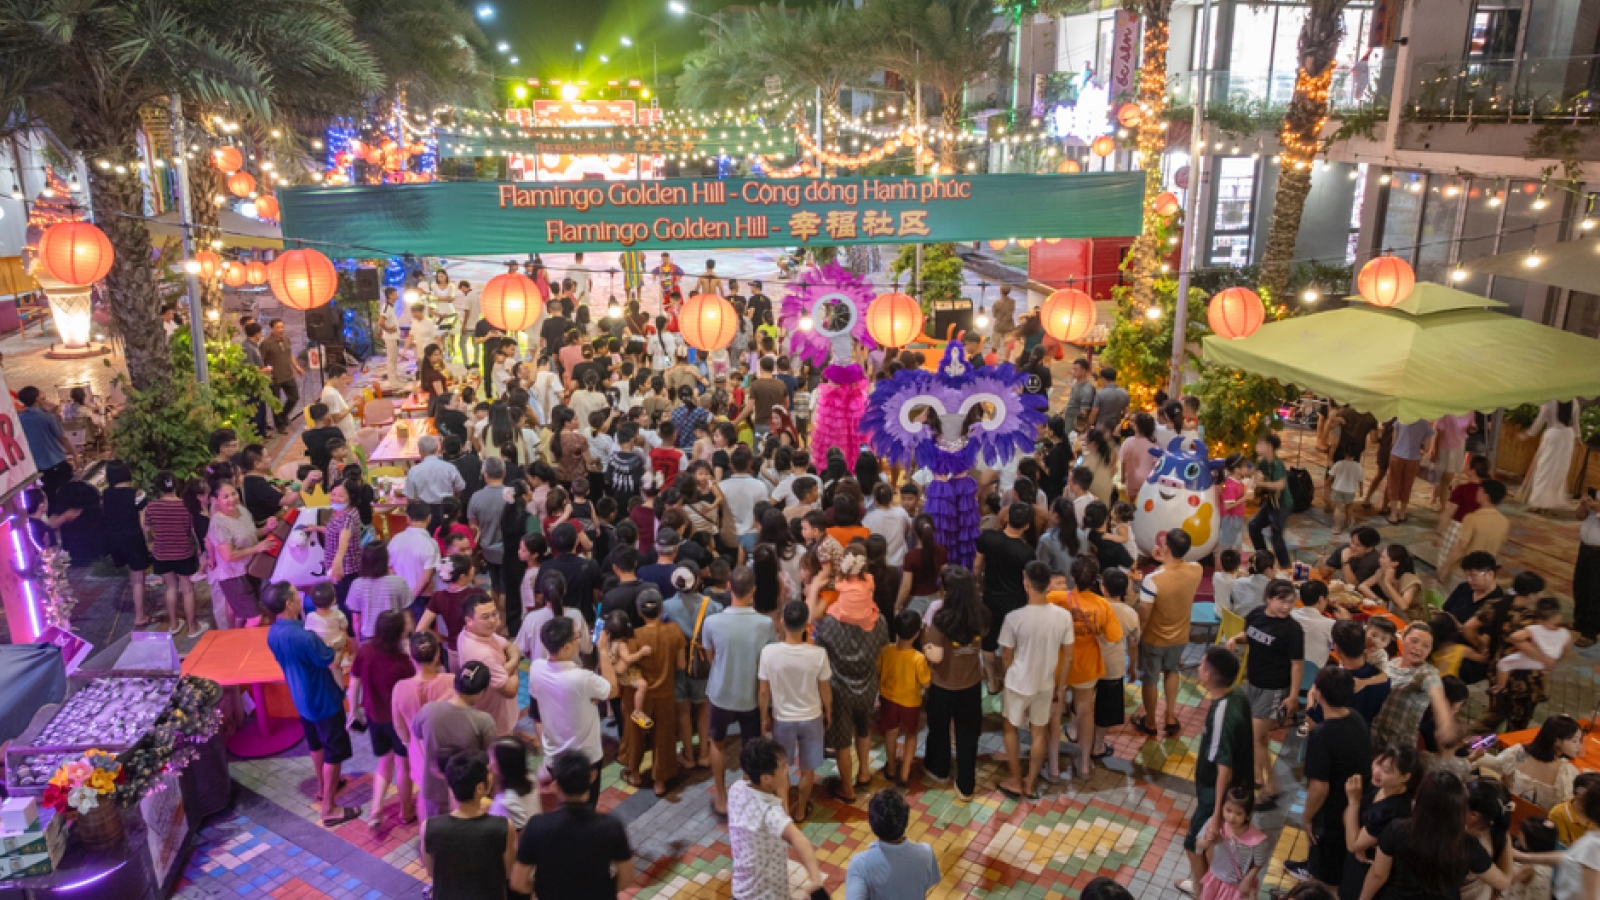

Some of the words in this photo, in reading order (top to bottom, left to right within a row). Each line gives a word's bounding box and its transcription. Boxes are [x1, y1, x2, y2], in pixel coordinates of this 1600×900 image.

[499, 185, 605, 211] Flamingo
[609, 182, 688, 206] Golden
[692, 182, 727, 204] Hill
[742, 181, 801, 207] Cộng
[863, 178, 917, 204] Hạnh
[920, 177, 972, 204] phúc
[546, 219, 650, 246] Flamingo
[653, 216, 732, 241] Golden
[734, 215, 769, 239] Hill
[789, 210, 931, 242] 幸福社区
[0, 412, 26, 476] R
